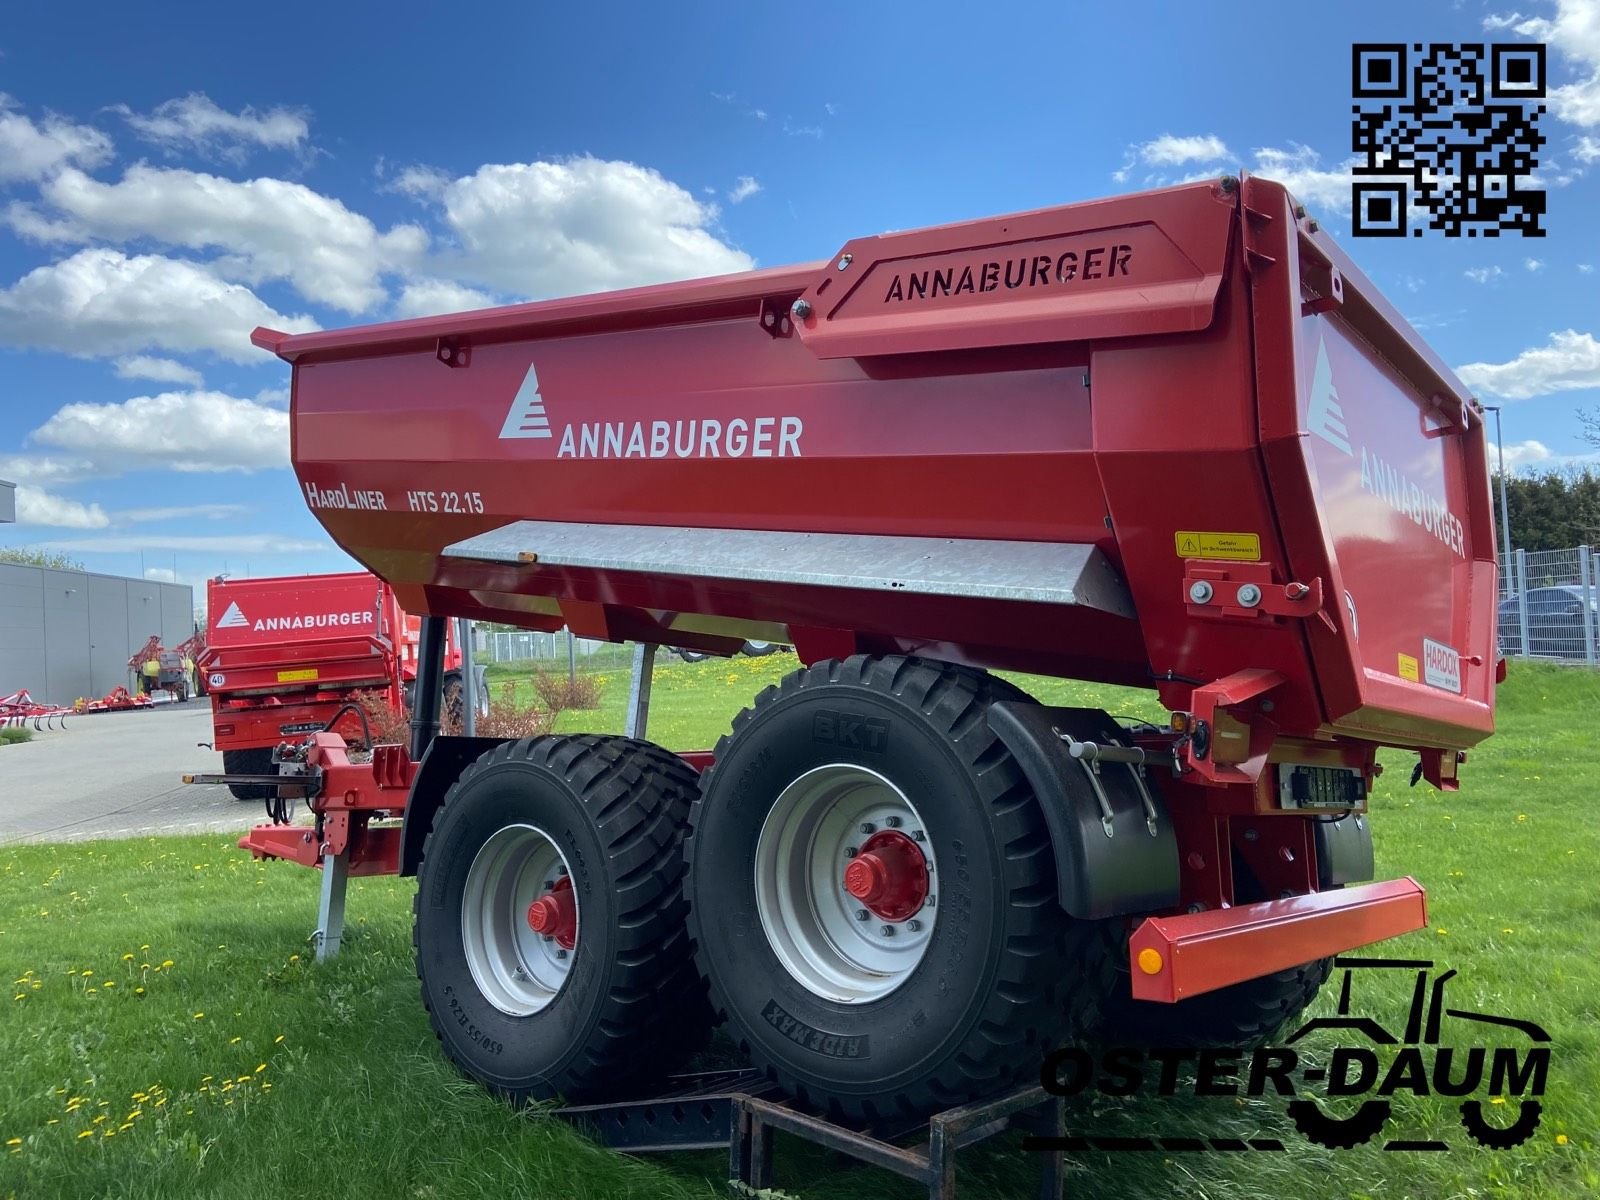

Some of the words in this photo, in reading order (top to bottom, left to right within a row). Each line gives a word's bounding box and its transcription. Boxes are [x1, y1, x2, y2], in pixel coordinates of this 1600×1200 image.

[884, 244, 1132, 303] ANNABURGER
[556, 416, 804, 459] ANNABURGER
[407, 490, 438, 513] HTS
[443, 491, 485, 515] 22.15
[1360, 446, 1466, 560] ANNABURGER
[253, 611, 373, 631] ANNABURGER
[1426, 643, 1457, 677] HARDOX
[211, 675, 223, 685] 40
[814, 713, 887, 749] BKT
[465, 1022, 504, 1056] 650/55
[767, 1007, 811, 1043] MAX
[809, 1032, 860, 1057] RIDE
